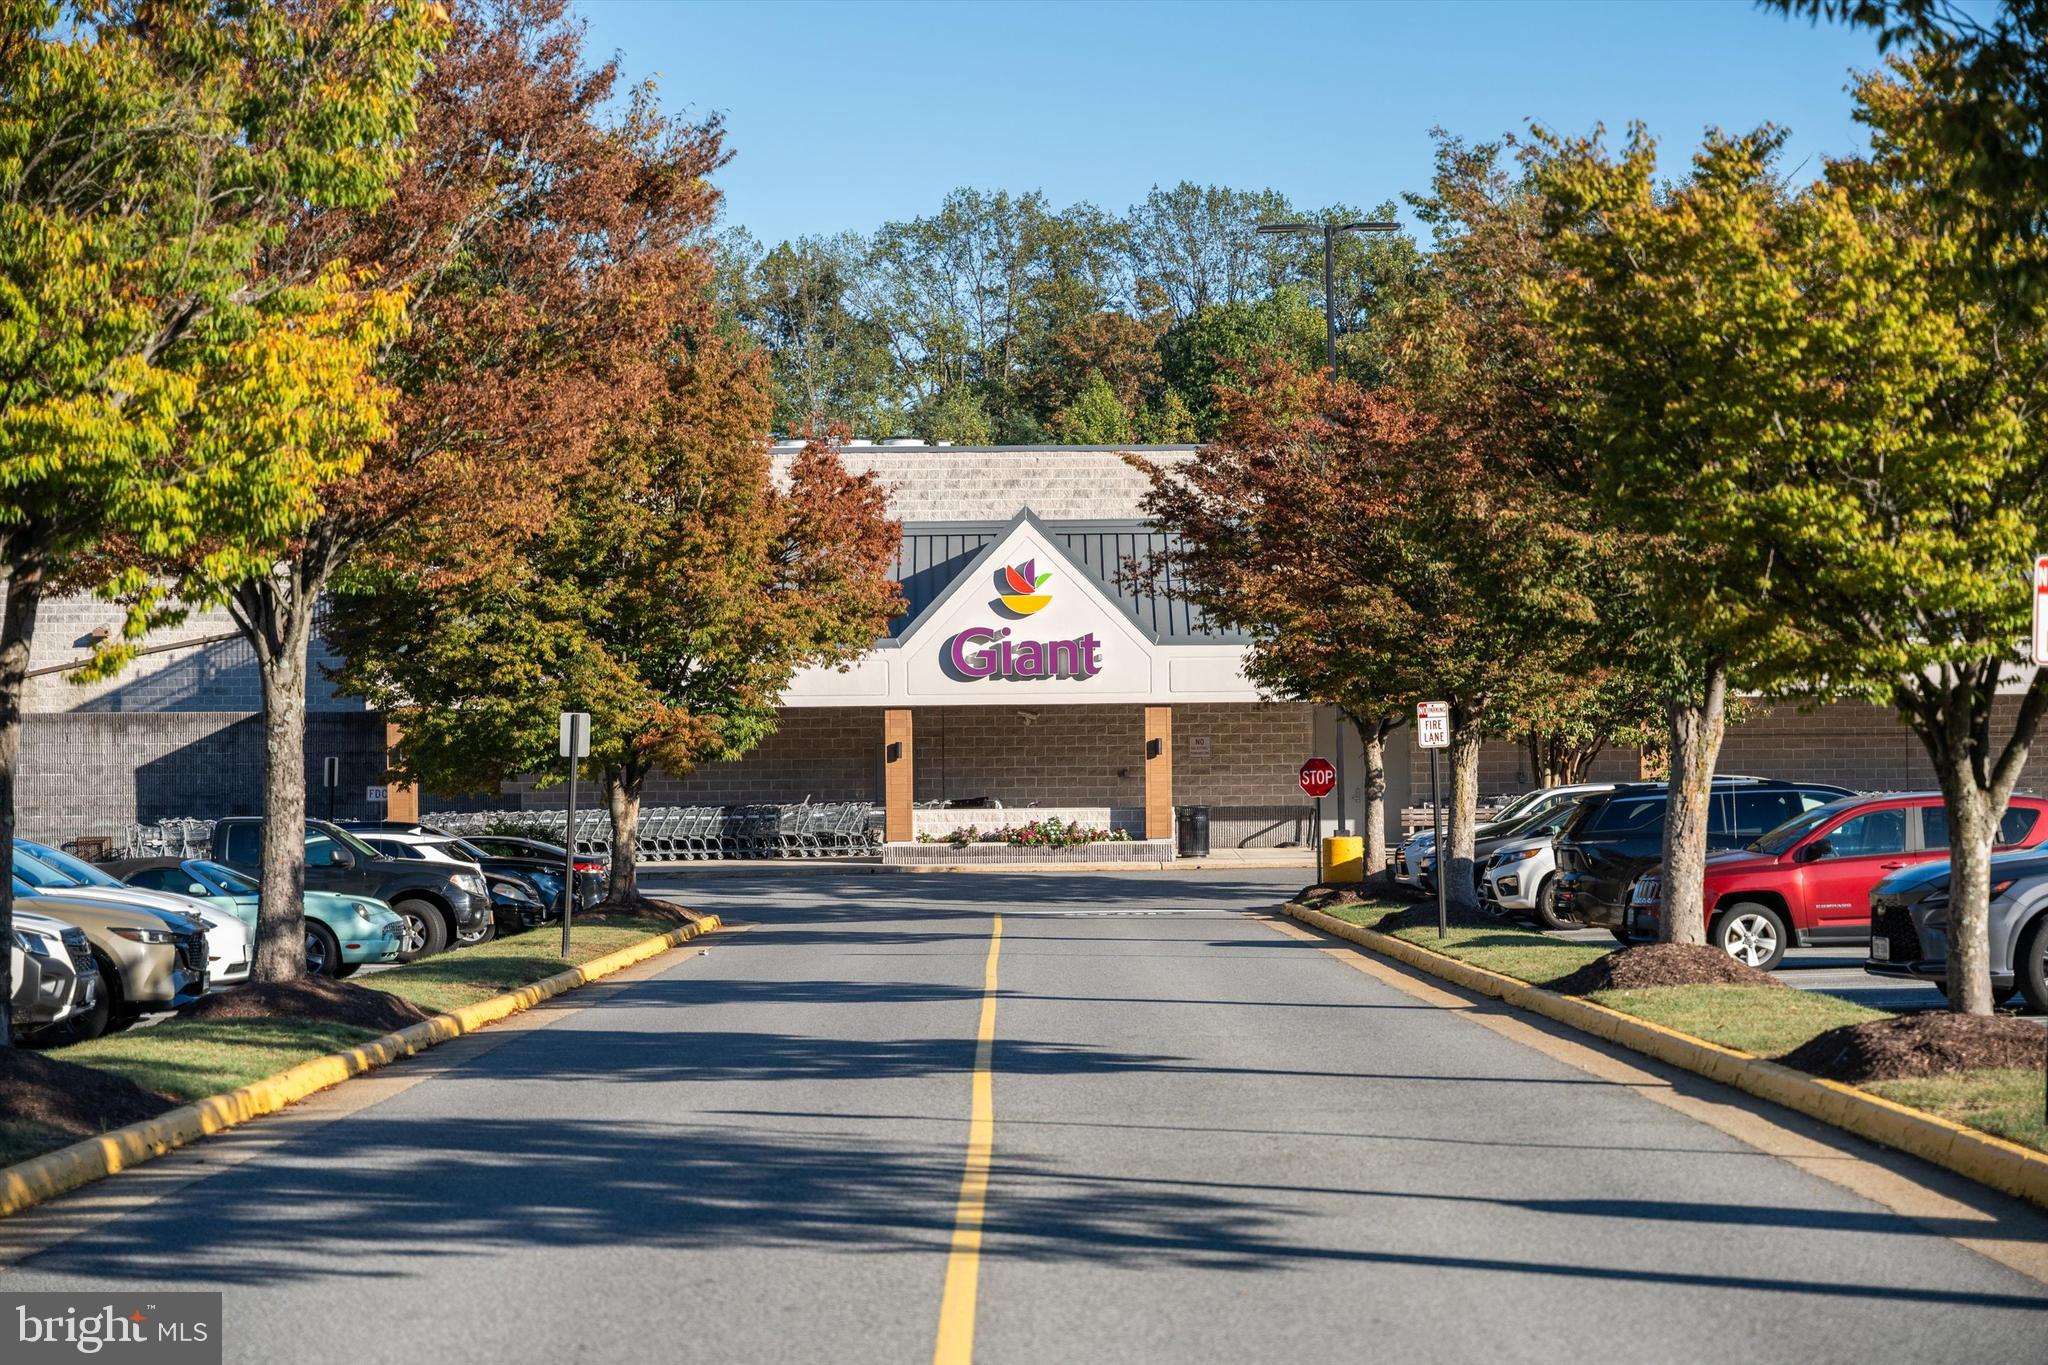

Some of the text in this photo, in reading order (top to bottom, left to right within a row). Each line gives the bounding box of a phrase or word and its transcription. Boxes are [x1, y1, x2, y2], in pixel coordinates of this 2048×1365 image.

[2039, 566, 2048, 587] N
[951, 626, 1102, 678] Giant
[1425, 720, 1442, 730] FIRE
[1195, 738, 1205, 746] NO
[1424, 732, 1444, 742] LANE
[1301, 769, 1334, 785] STOP
